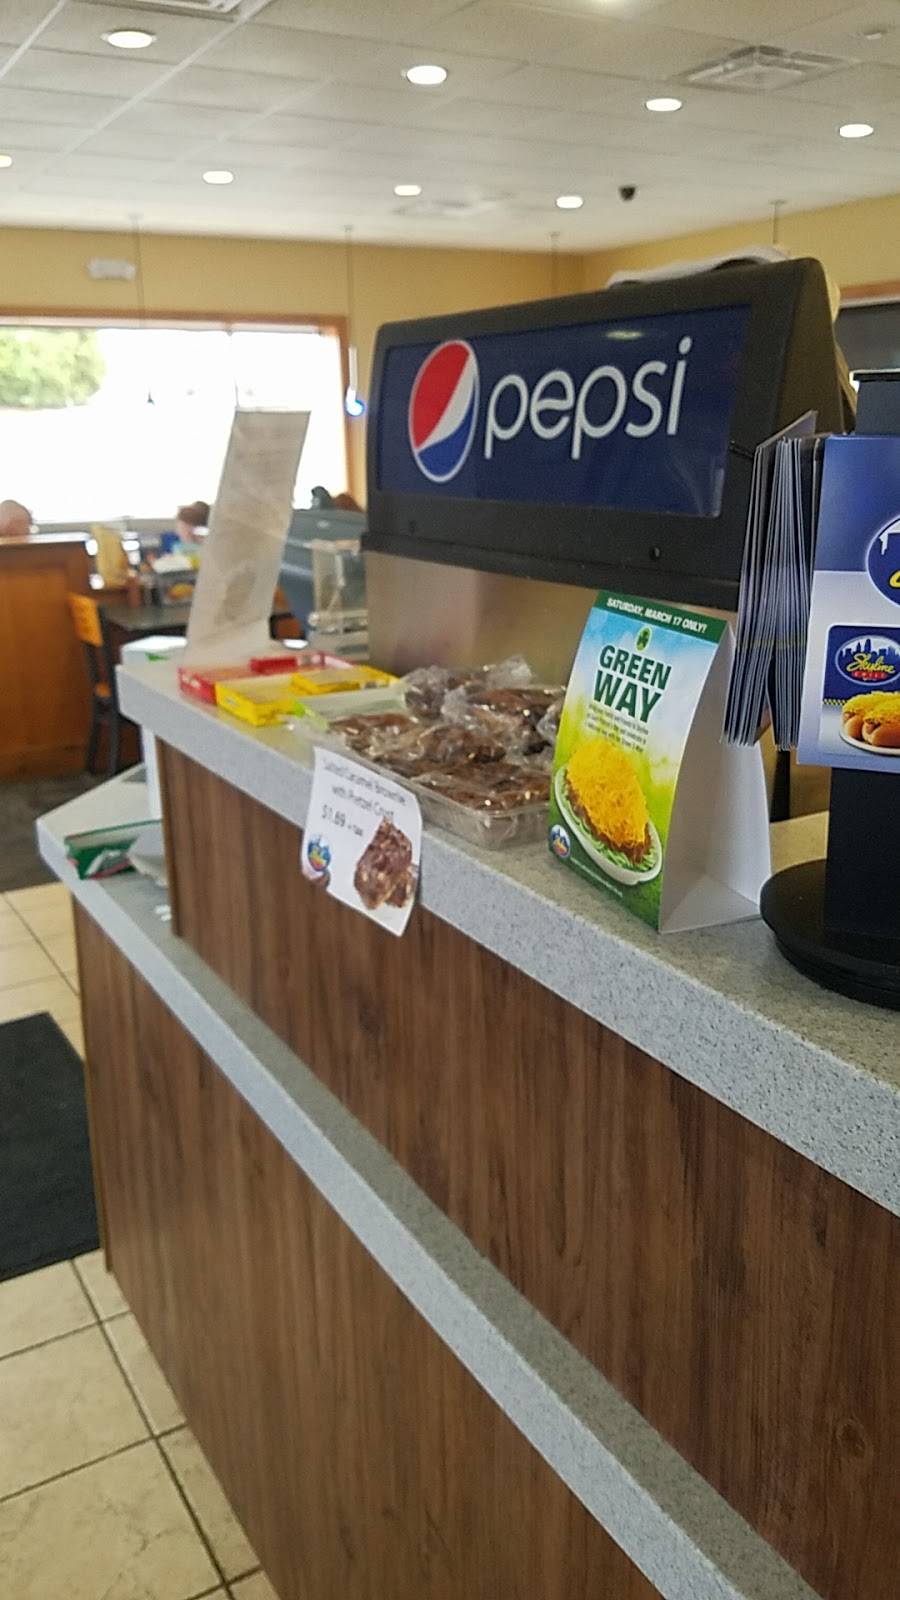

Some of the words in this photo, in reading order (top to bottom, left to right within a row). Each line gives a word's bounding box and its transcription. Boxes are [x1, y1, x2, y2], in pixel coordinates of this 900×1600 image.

[484, 335, 693, 460] pepsi
[606, 597, 644, 616] SATURDAY,
[644, 607, 672, 624] MARCH
[672, 615, 683, 626] 17
[682, 618, 708, 633] ONLY!
[599, 644, 672, 690] GREEN
[846, 652, 896, 674] Skyline
[593, 669, 662, 723] WAY
